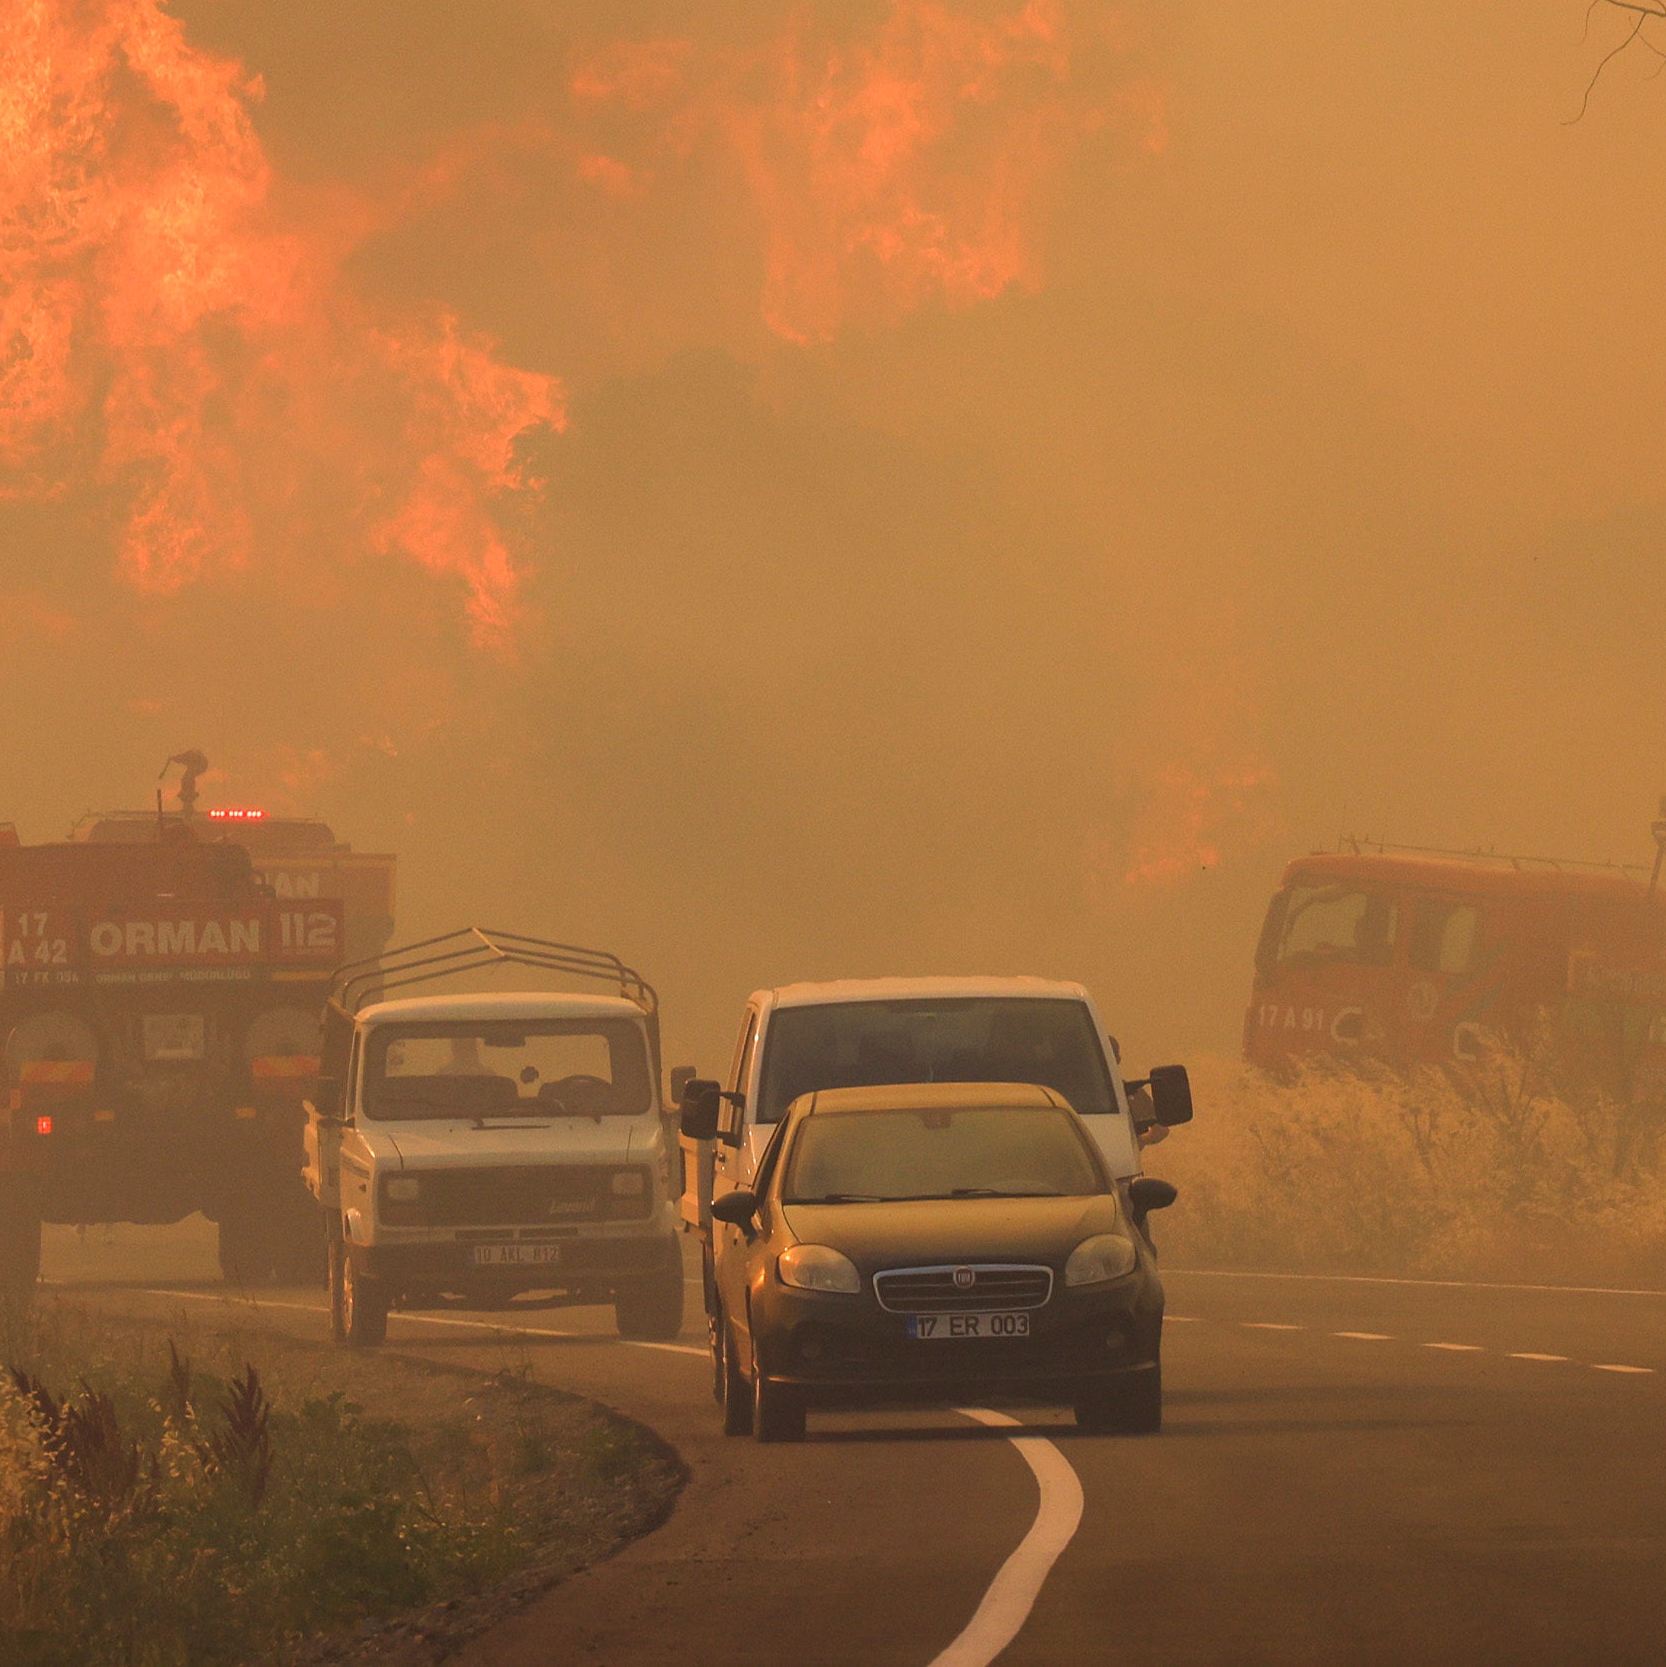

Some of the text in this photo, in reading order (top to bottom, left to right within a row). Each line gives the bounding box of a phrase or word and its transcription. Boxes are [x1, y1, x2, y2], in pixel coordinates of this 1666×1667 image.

[18, 912, 48, 937] 17
[279, 912, 337, 946] 112
[90, 919, 260, 957] ORMAN
[7, 939, 25, 965] A
[35, 939, 67, 964] 42
[1259, 1004, 1325, 1031] 17 A 91
[477, 1247, 491, 1262] 10
[918, 1317, 937, 1337] 17
[950, 1316, 979, 1336] ER
[991, 1315, 1027, 1335] 003
